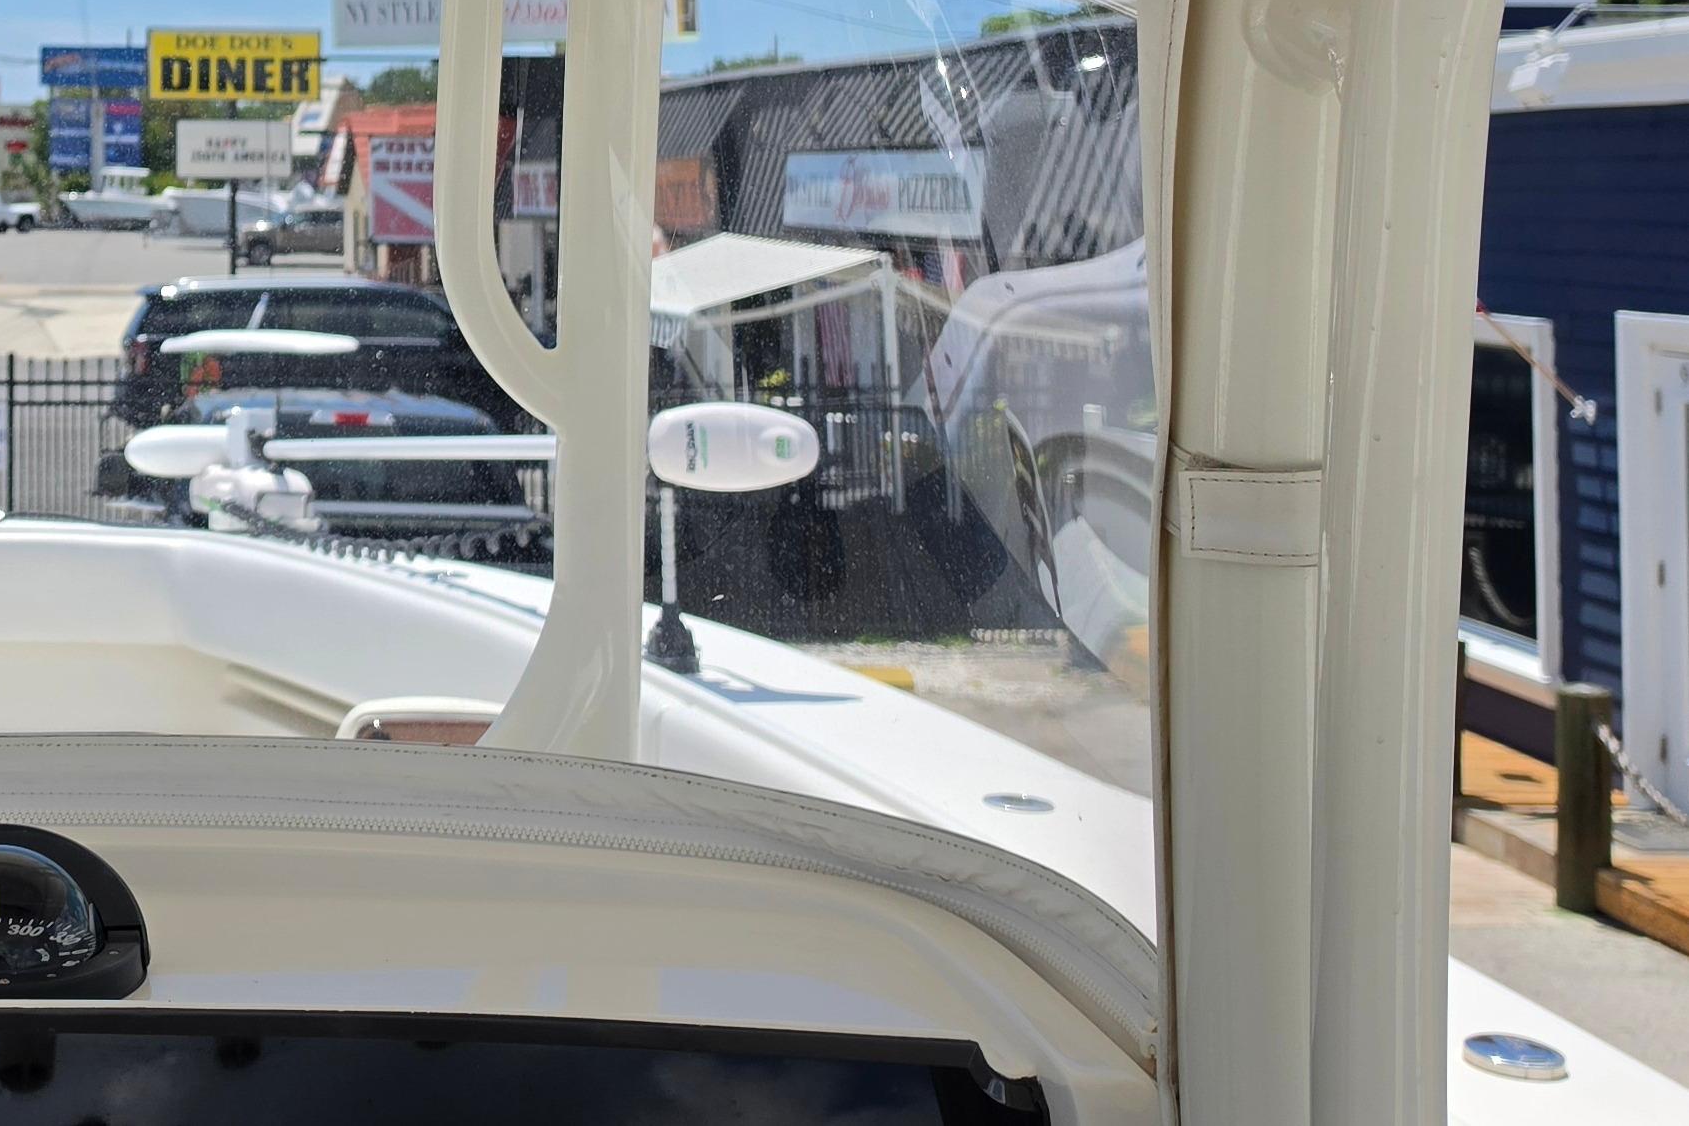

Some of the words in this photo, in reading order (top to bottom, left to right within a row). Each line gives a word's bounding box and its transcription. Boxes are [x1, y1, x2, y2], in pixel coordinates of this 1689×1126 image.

[175, 34, 216, 50] DOE
[160, 56, 311, 93] DINER
[7, 924, 44, 937] 300
